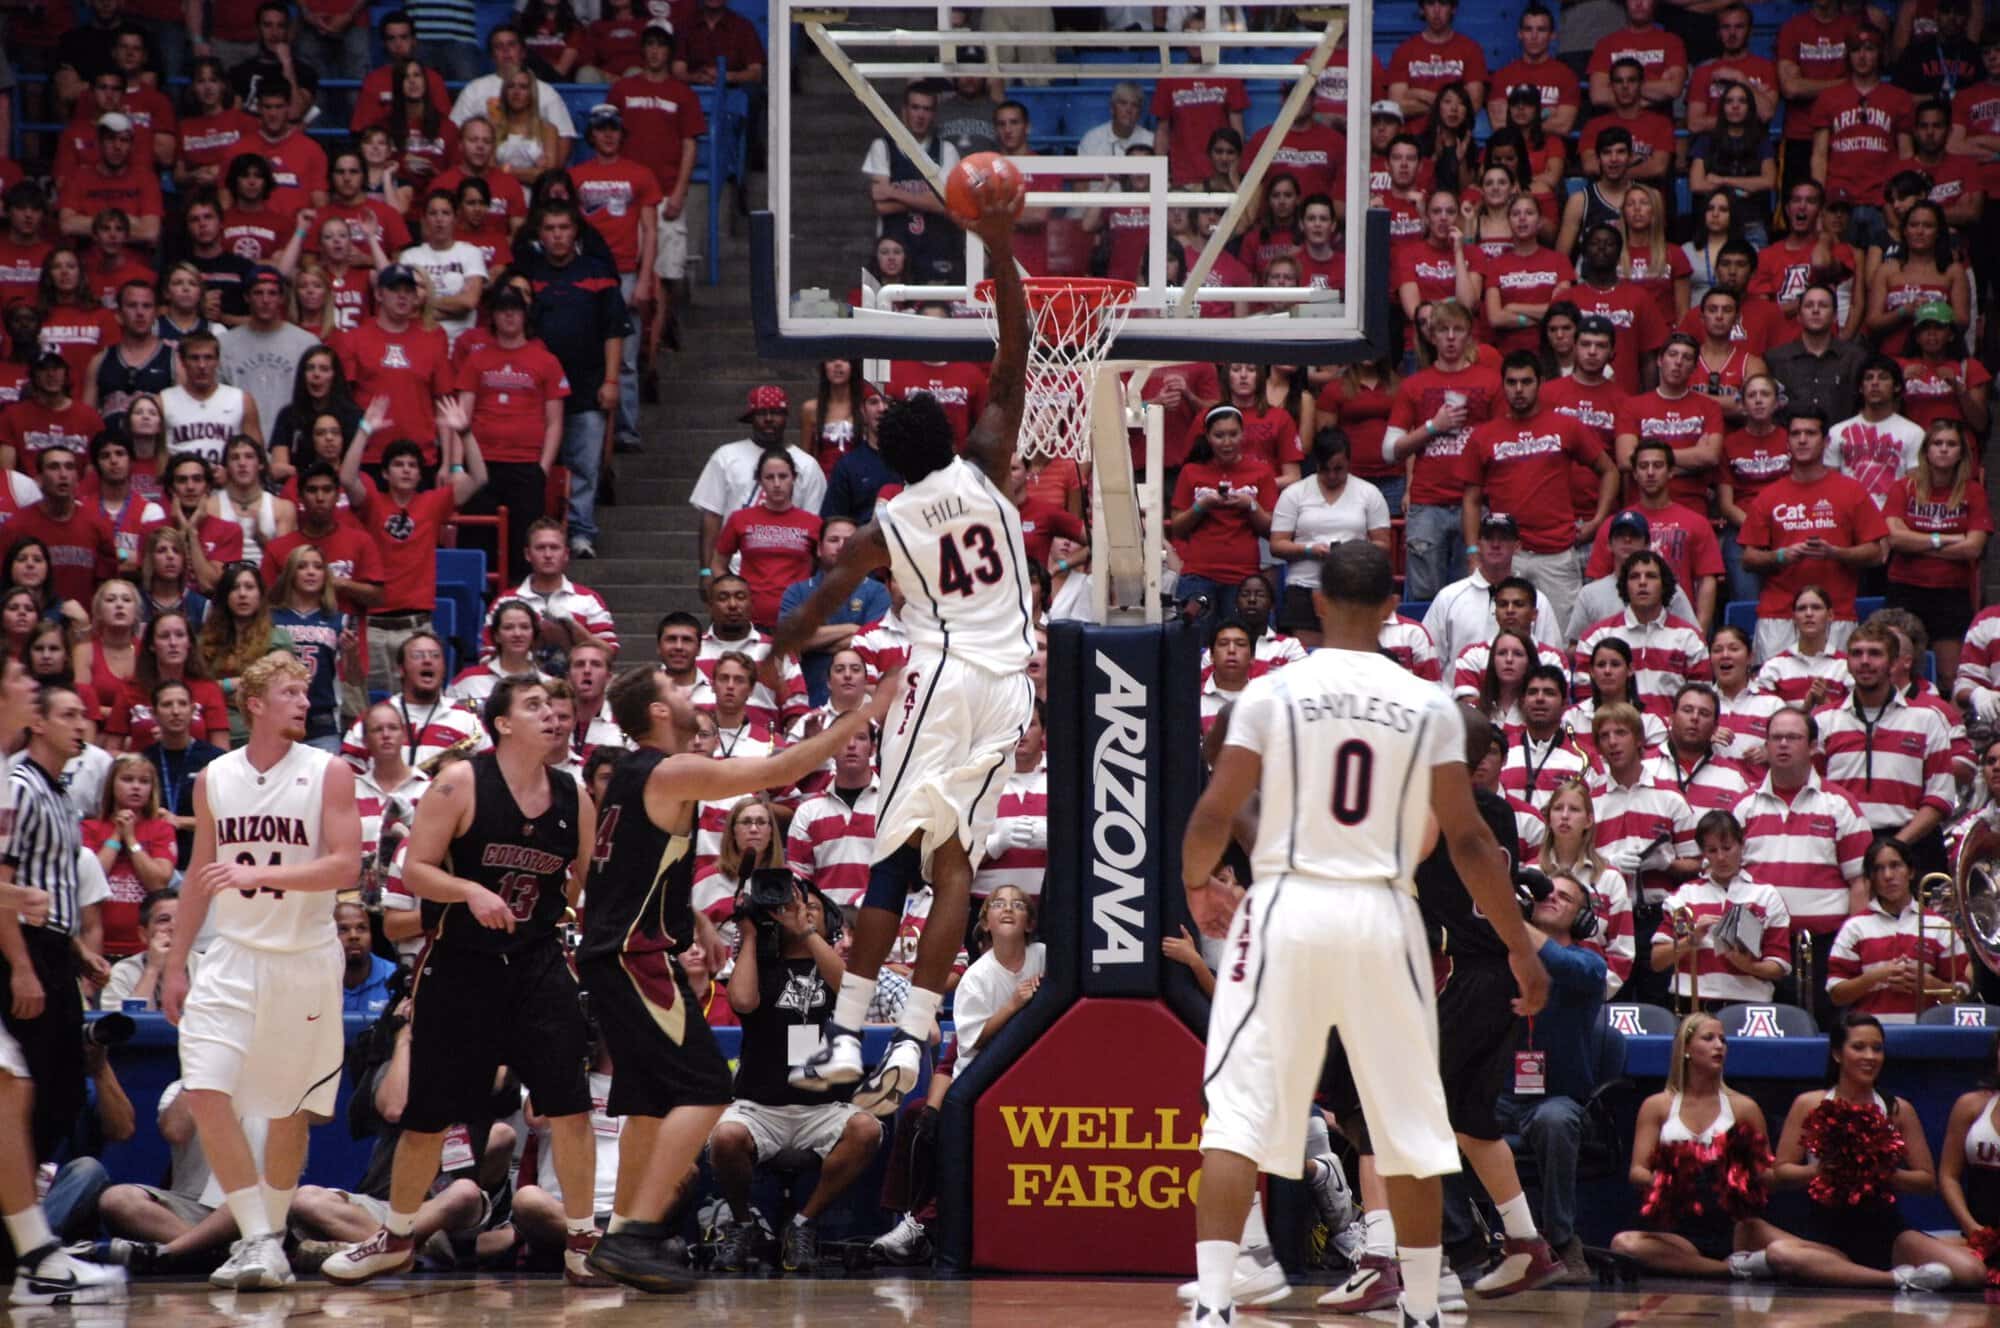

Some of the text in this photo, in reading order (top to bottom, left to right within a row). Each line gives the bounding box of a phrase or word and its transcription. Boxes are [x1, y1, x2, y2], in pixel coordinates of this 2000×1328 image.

[922, 496, 970, 529] HILL
[1773, 503, 1806, 521] Cat
[1783, 518, 1838, 531] touch this.
[939, 523, 1004, 598] 43
[1298, 692, 1416, 734] BAYLESS
[1331, 737, 1375, 827] 0
[1092, 648, 1148, 965] ARIZONA
[218, 814, 310, 848] ARIZONA
[499, 872, 541, 922] 13
[1000, 1106, 1205, 1150] WELL
